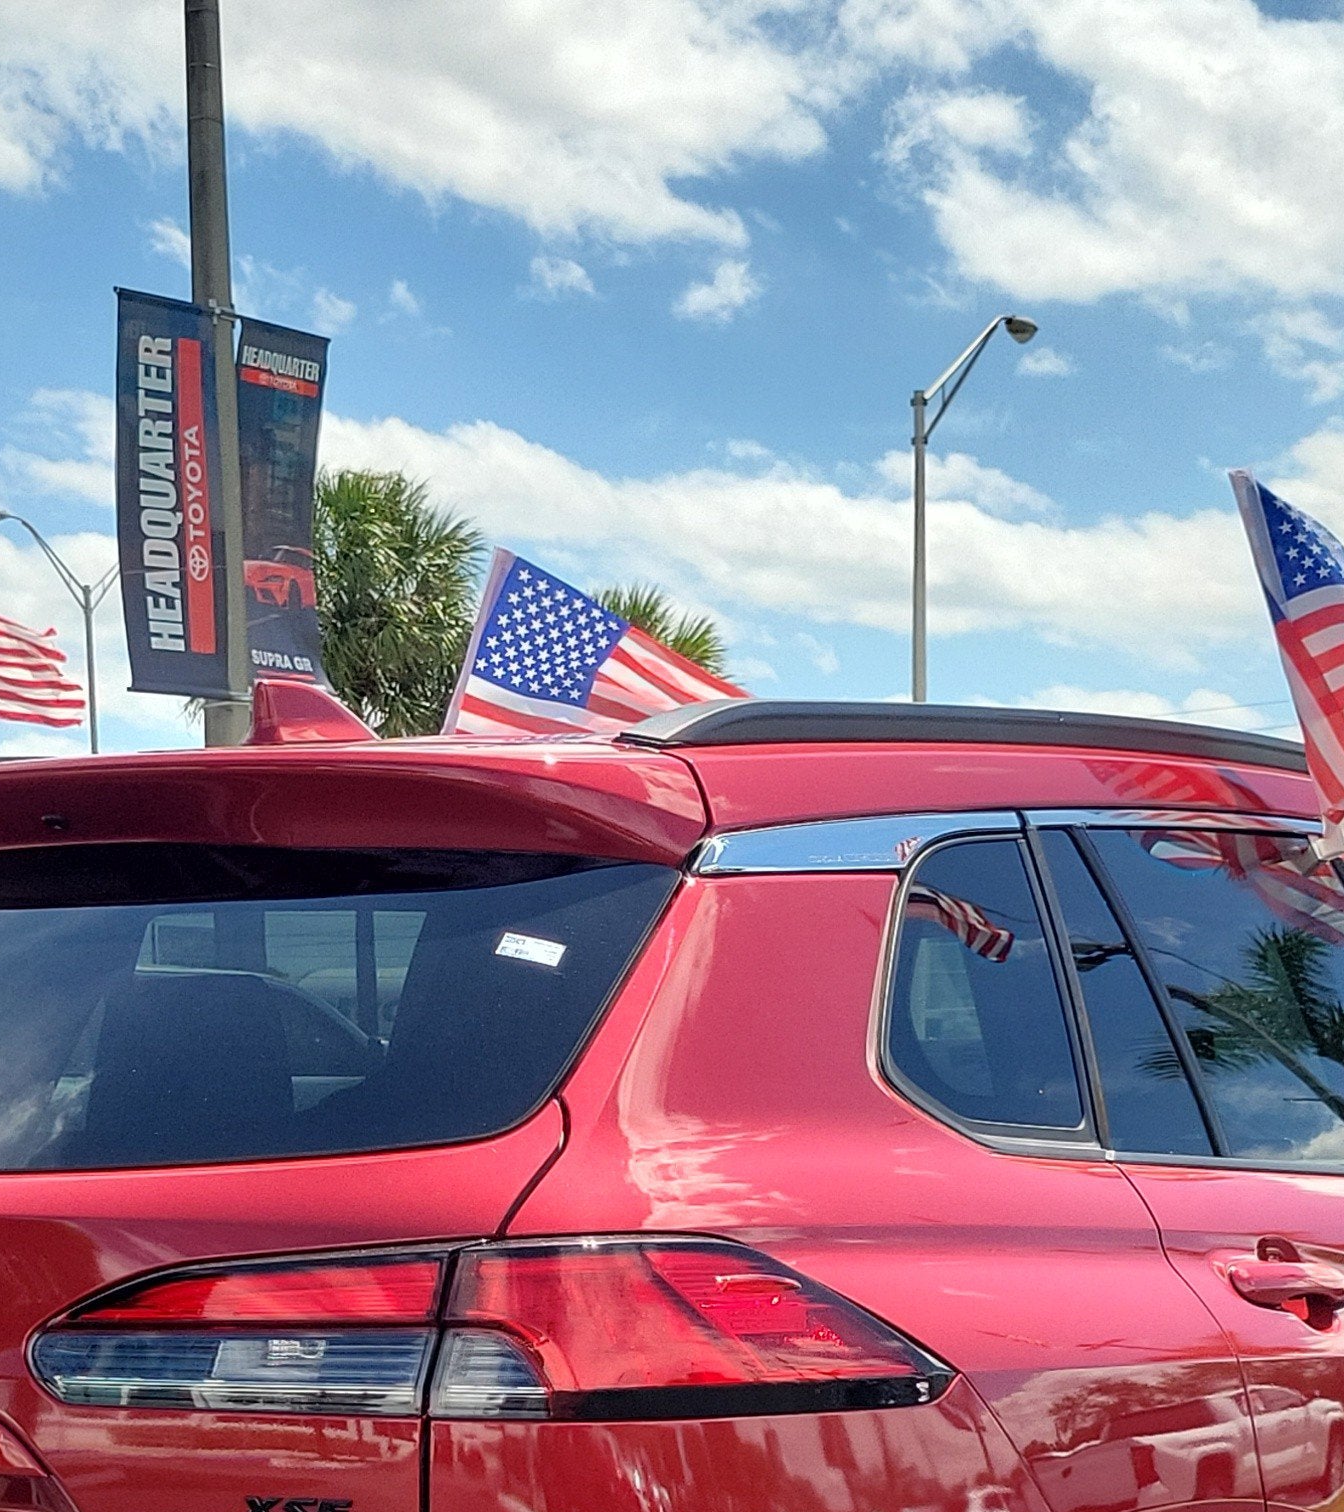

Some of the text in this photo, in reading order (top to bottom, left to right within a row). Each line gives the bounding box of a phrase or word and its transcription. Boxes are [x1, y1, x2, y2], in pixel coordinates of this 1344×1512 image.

[241, 345, 320, 382] HEADQUARTER
[137, 334, 186, 653] HEADQUARTER
[182, 425, 205, 541] TOYOTA
[251, 649, 313, 672] SUPRA GR
